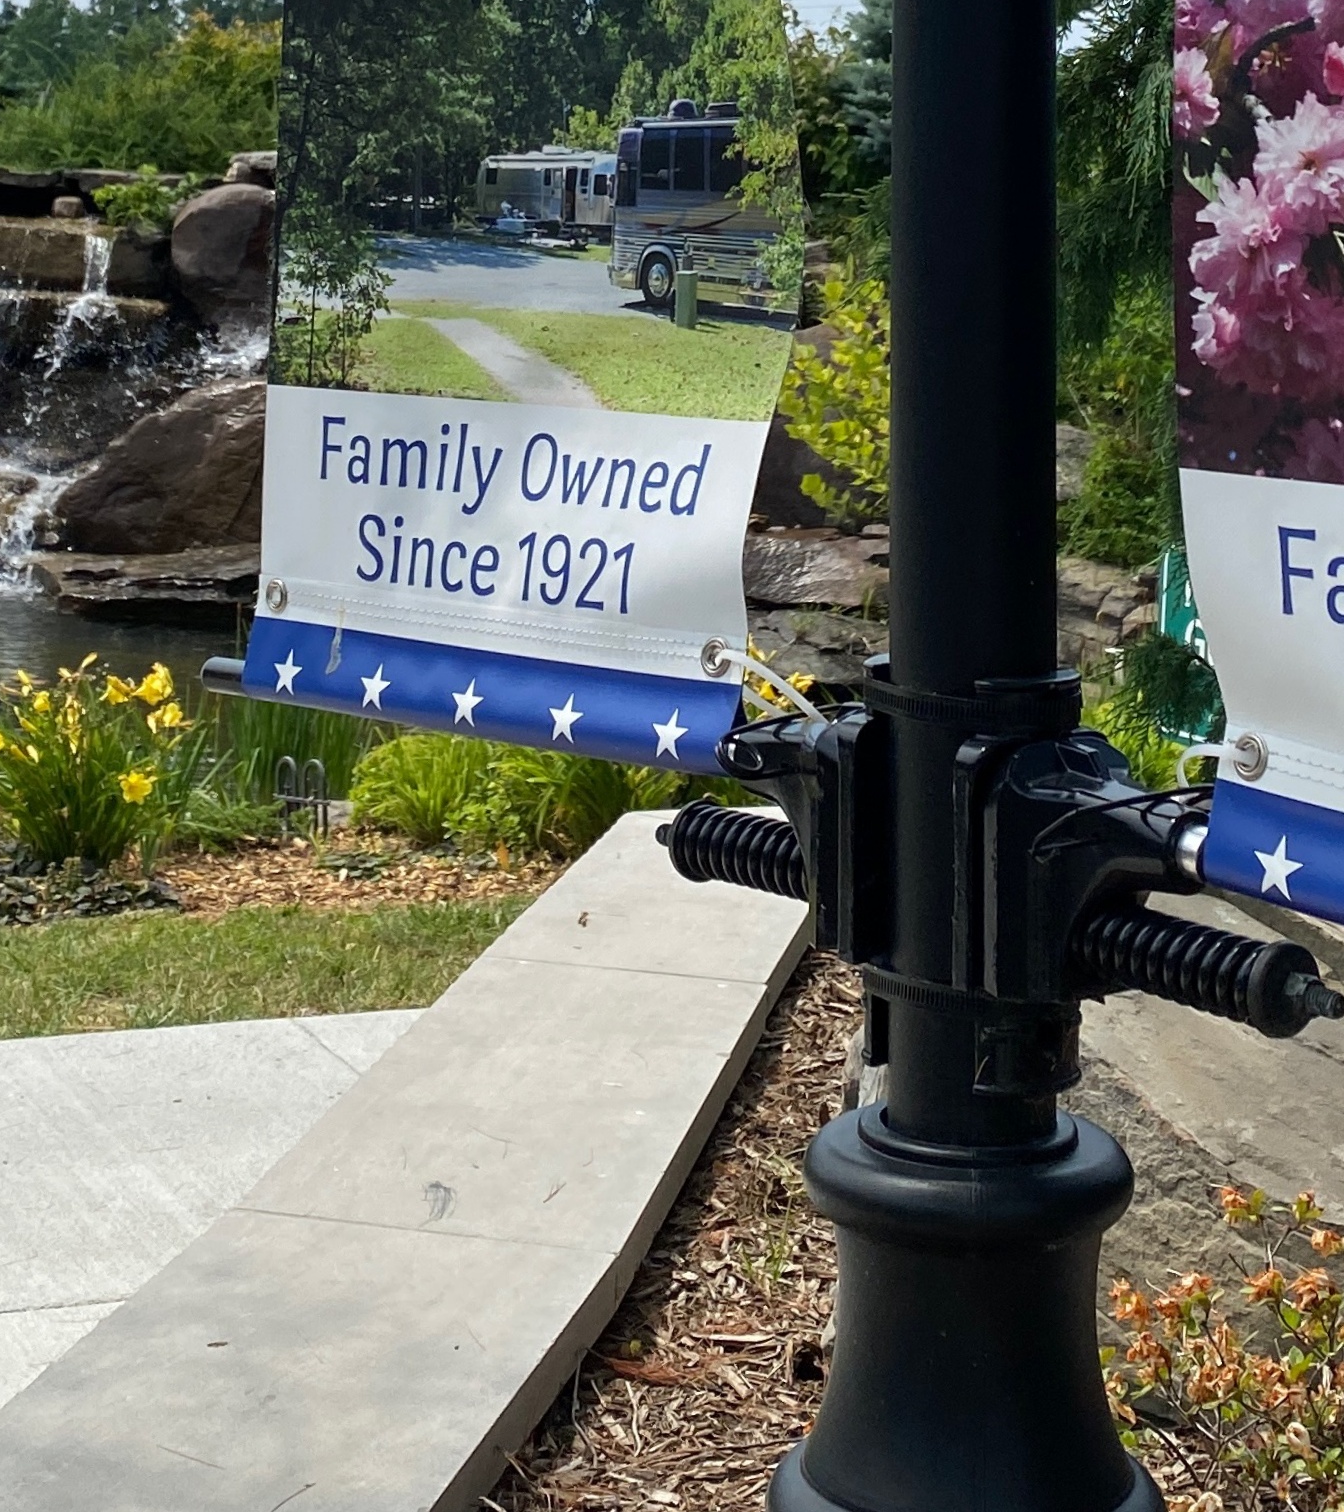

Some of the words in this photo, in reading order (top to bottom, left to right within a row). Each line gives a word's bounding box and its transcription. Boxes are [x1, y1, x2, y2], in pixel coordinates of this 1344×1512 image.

[320, 417, 501, 515] Family
[522, 434, 710, 515] Owned
[357, 514, 499, 596] Since
[520, 534, 633, 614] 1921
